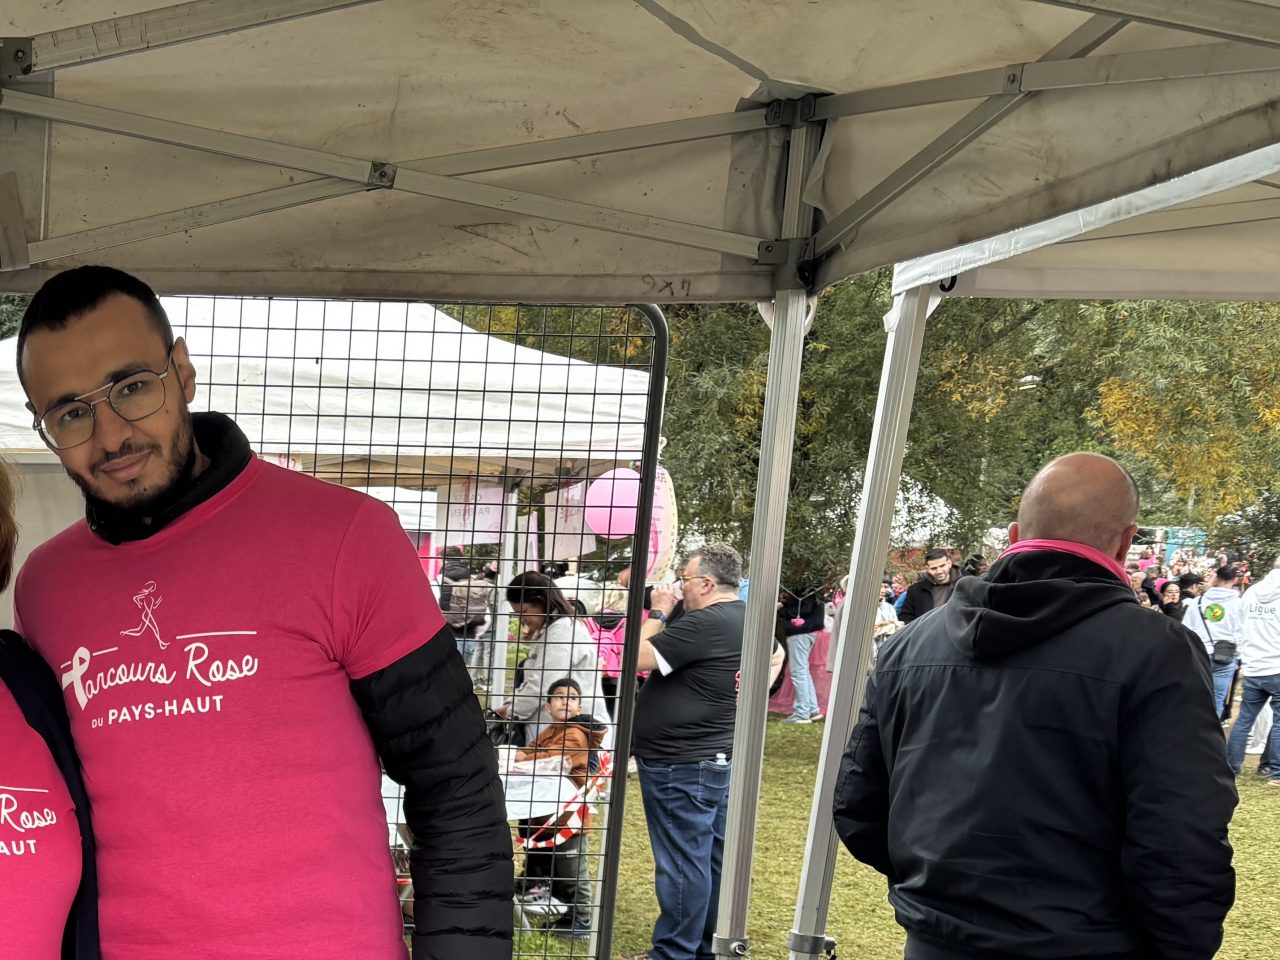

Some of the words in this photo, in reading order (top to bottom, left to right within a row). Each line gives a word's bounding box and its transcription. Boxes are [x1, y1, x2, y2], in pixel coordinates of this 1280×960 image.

[1249, 604, 1276, 616] Ligue
[61, 646, 177, 712] Parcours
[184, 642, 259, 687] Rose
[91, 717, 104, 729] DU
[108, 695, 224, 725] PAYS-HAUT
